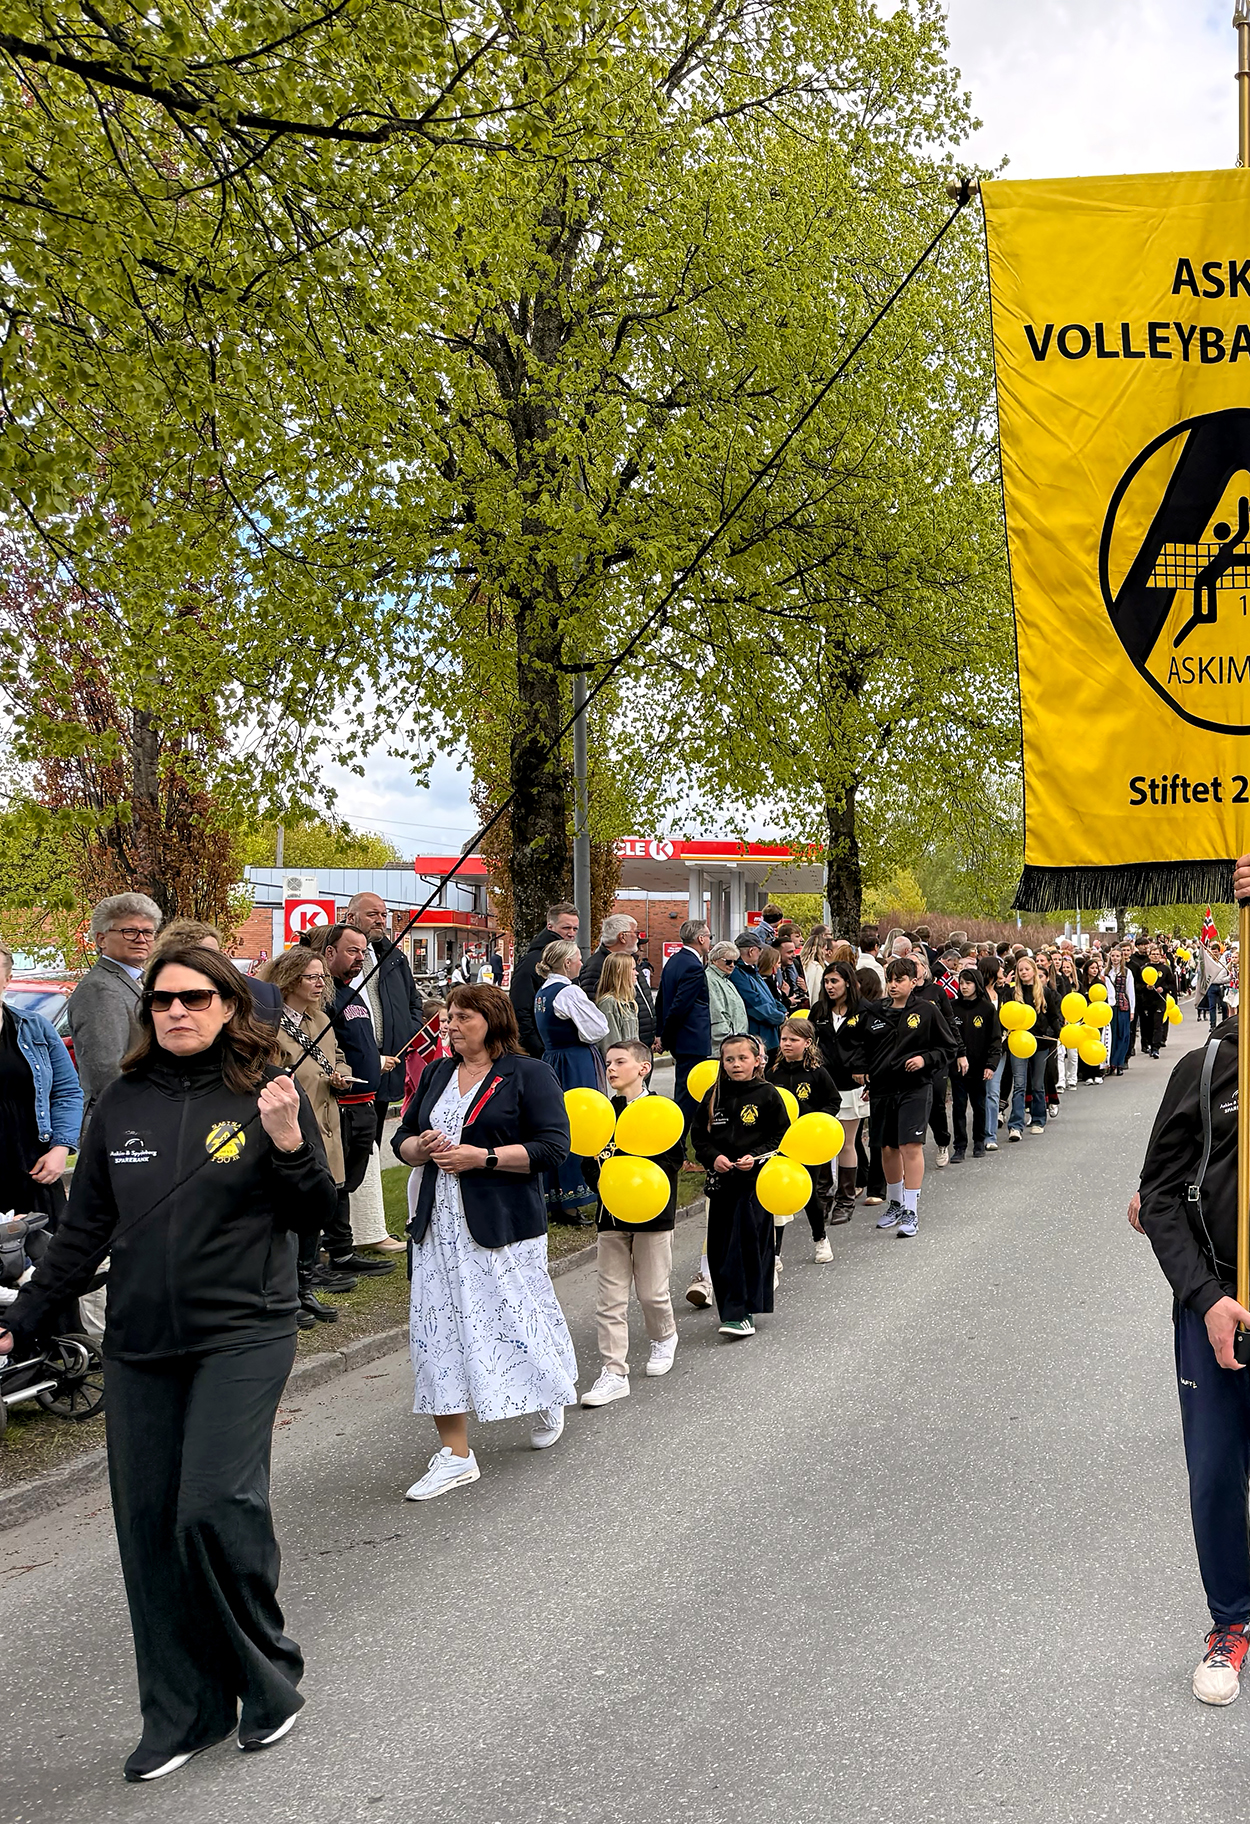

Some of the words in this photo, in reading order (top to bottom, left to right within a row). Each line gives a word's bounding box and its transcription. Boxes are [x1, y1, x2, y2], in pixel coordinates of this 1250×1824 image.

[1129, 773, 1223, 806] Stiftet
[656, 842, 671, 859] K
[300, 911, 321, 931] K
